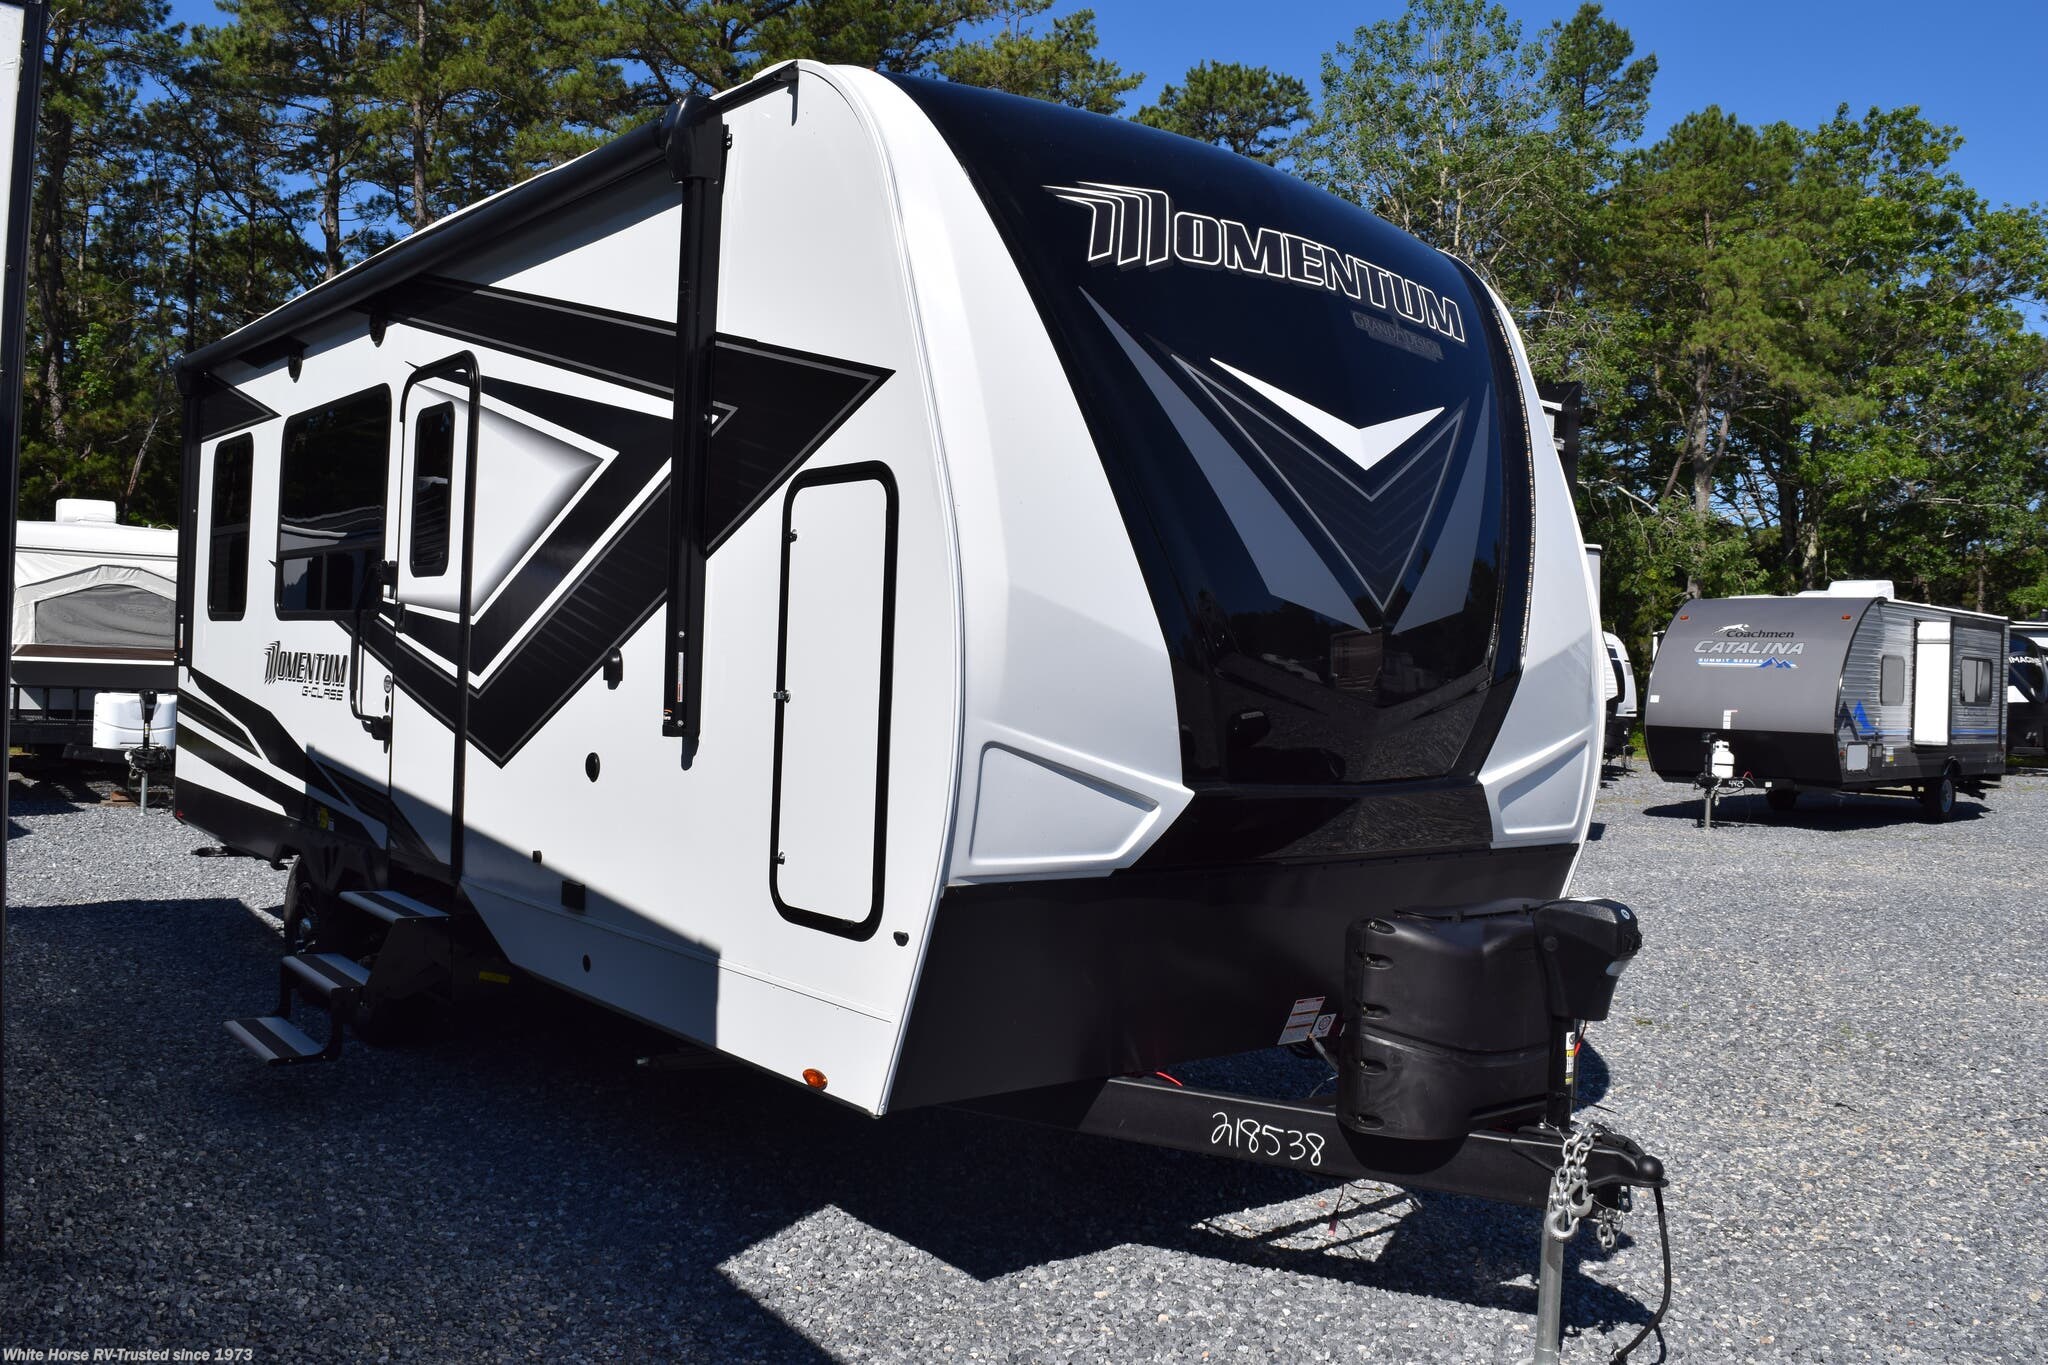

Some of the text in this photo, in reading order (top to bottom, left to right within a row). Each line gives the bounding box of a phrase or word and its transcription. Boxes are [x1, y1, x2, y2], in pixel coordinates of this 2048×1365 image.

[1042, 181, 1465, 343] MOMENTUM
[1694, 640, 1804, 655] CATALINA
[1726, 629, 1794, 638] Coachmen
[263, 640, 349, 687] MOMENTUM
[301, 685, 343, 701] G-CLASS
[1210, 1111, 1326, 1167] 218538
